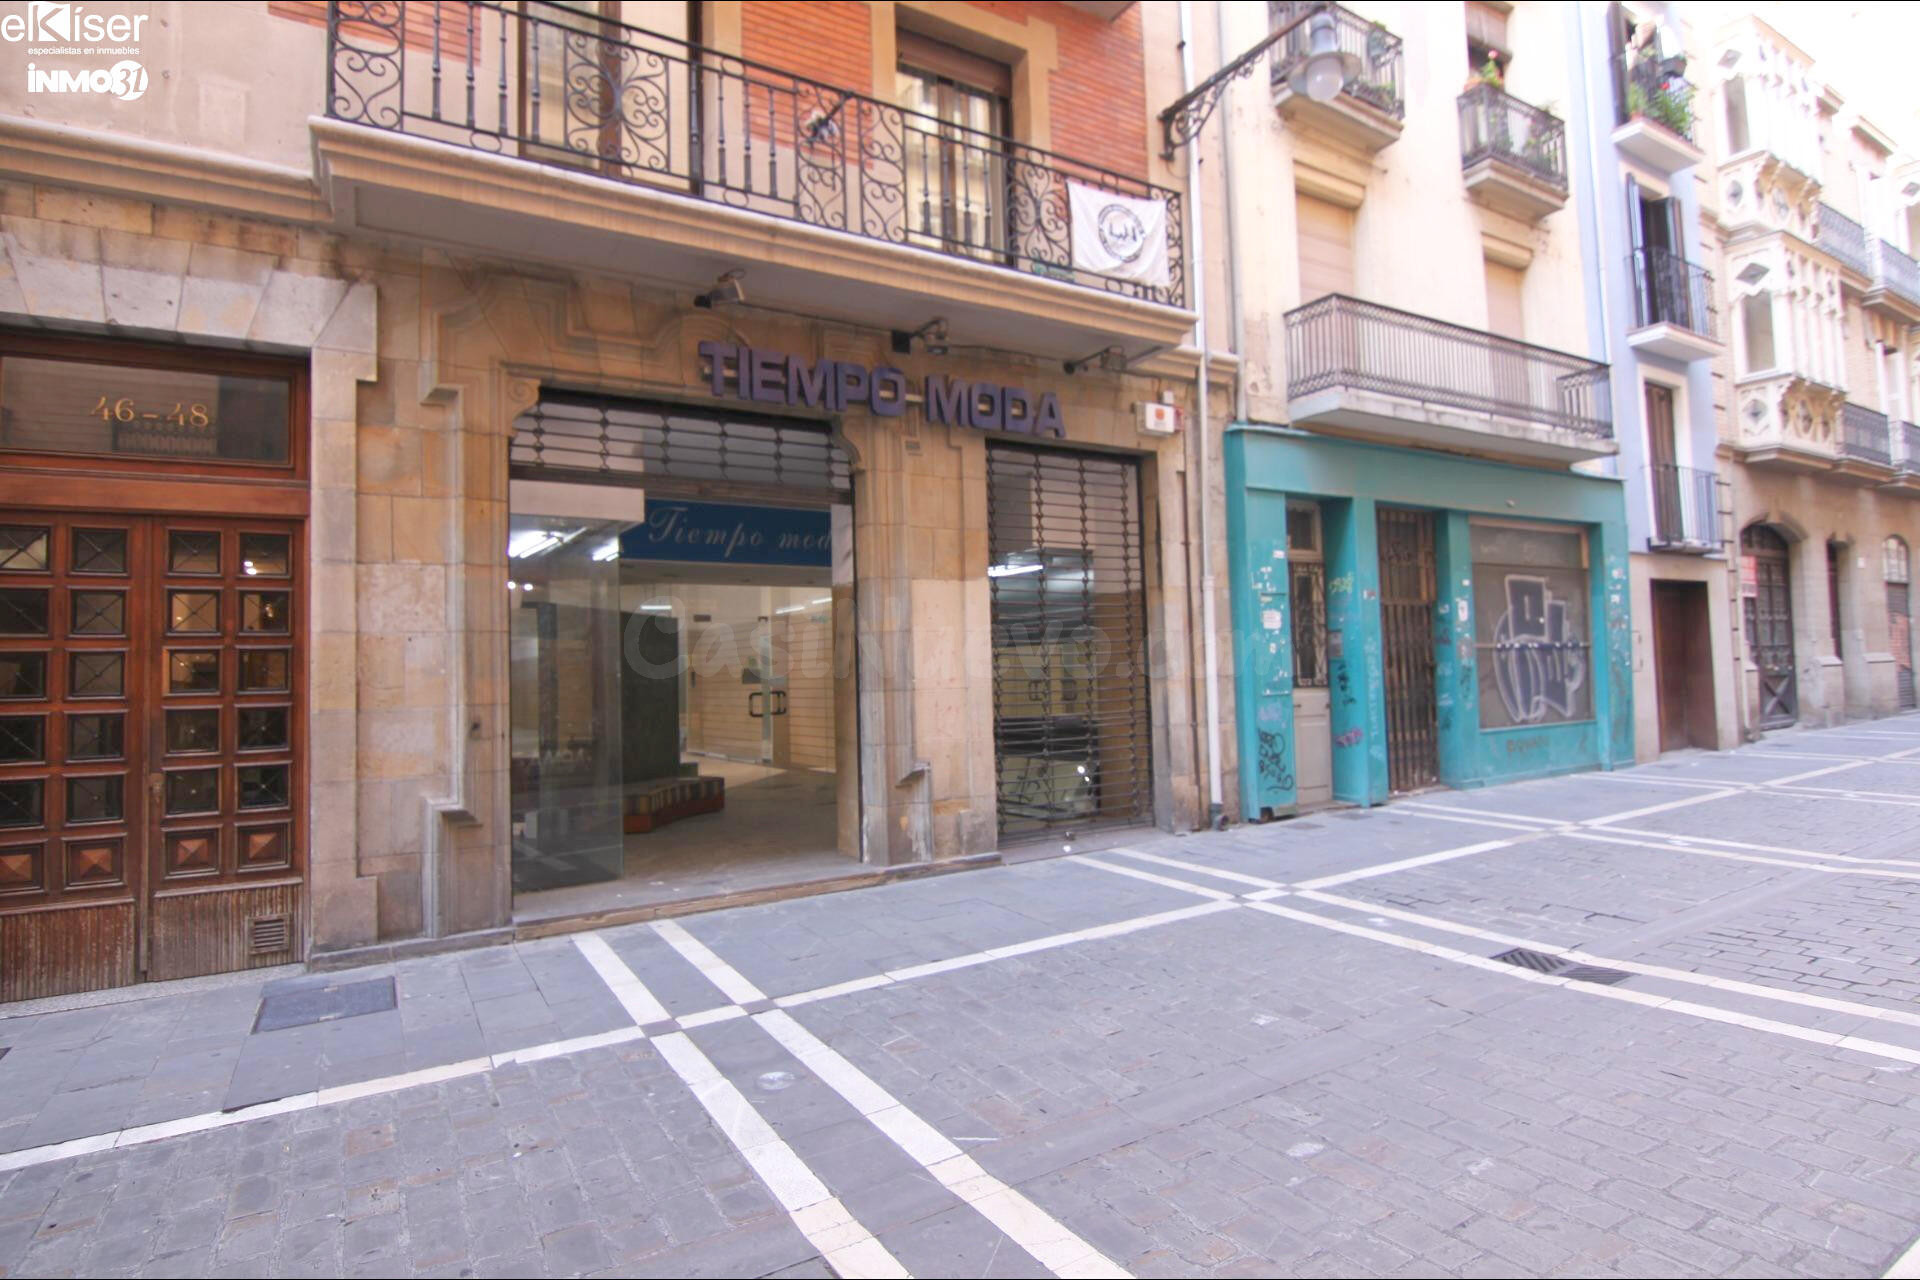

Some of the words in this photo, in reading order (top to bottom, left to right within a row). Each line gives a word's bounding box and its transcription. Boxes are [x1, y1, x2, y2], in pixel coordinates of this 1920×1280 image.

[700, 341, 907, 417] TIEMPO
[924, 374, 1066, 438] MODA
[649, 507, 765, 558] Tiempo
